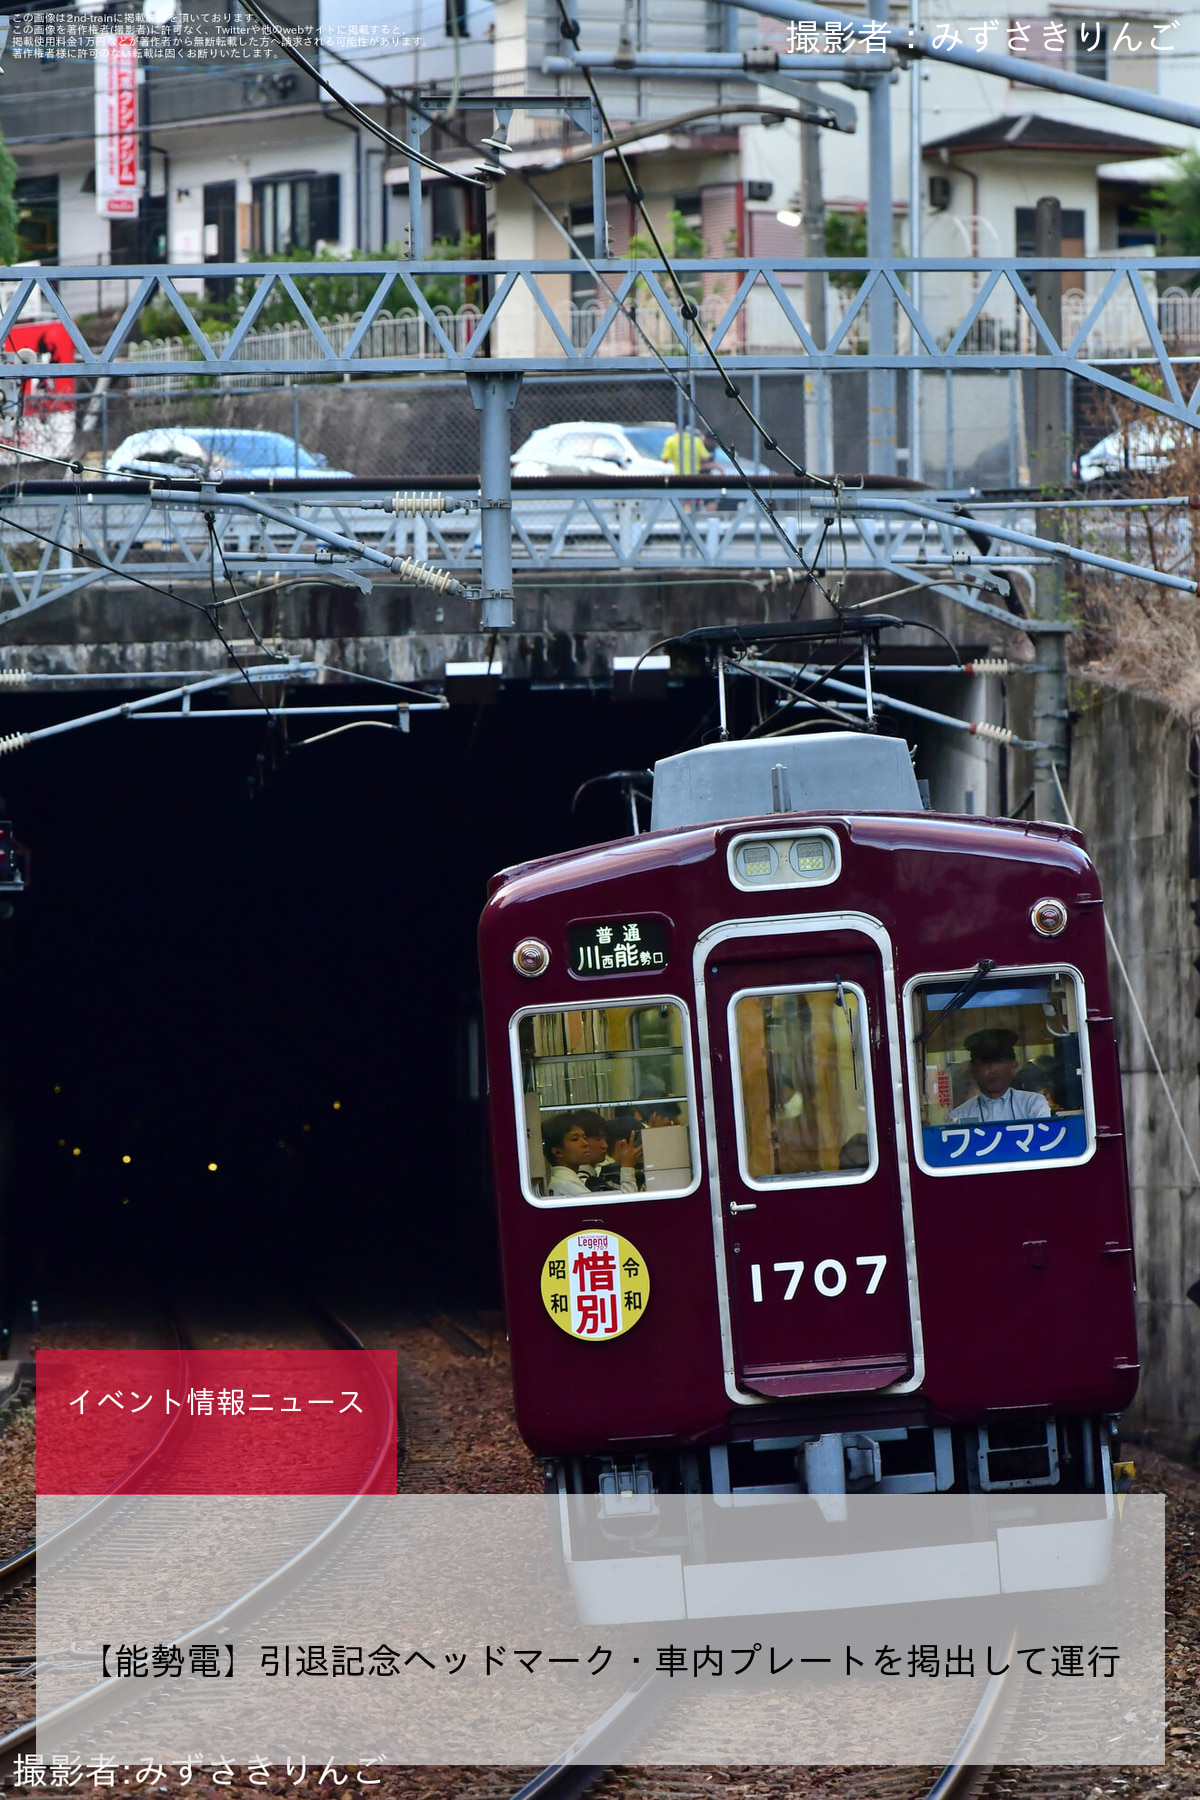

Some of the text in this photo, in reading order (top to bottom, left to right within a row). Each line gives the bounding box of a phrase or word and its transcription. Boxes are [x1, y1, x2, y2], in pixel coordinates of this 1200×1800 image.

[596, 923, 641, 944] 普通
[577, 943, 664, 971] 川西能勢口
[942, 1123, 1067, 1159] ワンマン
[578, 1235, 608, 1249] Legend
[548, 1259, 569, 1314] 昭和
[572, 1250, 619, 1335] 惜別
[622, 1257, 642, 1311] 令和
[751, 1254, 888, 1303] 1707
